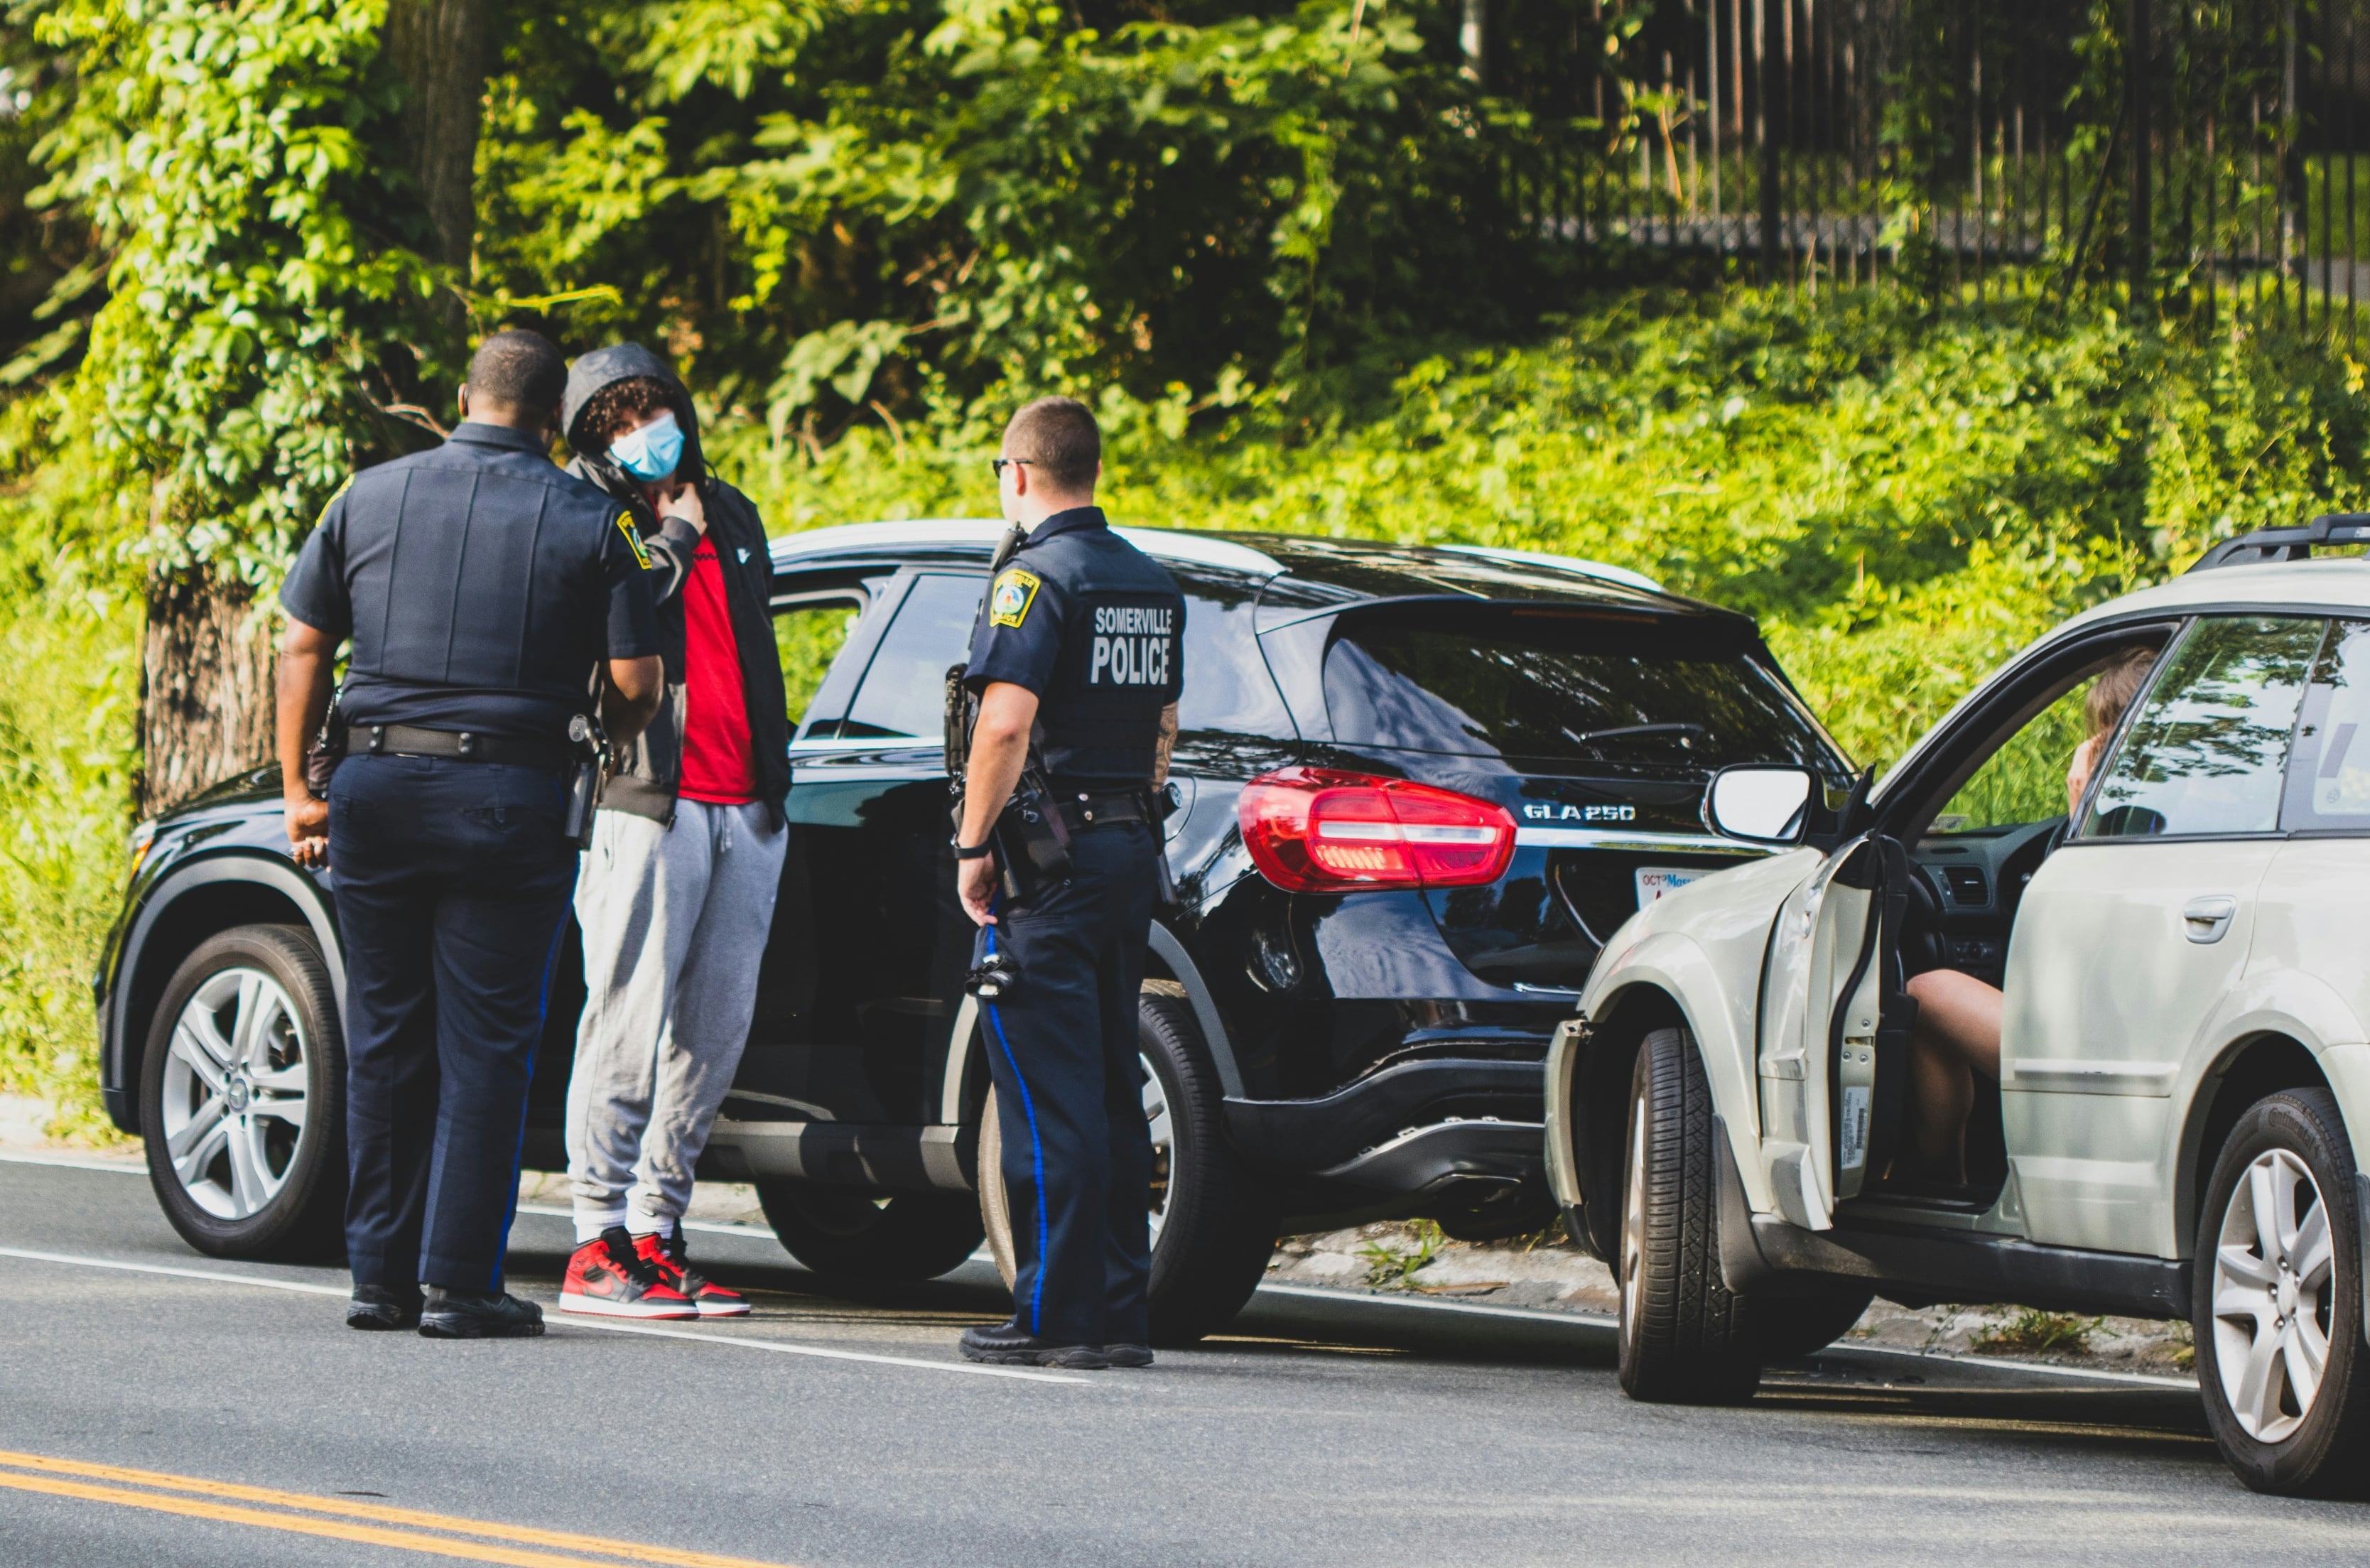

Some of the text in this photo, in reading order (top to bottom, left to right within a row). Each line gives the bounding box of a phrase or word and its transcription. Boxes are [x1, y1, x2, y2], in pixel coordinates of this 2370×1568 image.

[1095, 607, 1172, 634] SOMERVILLE
[1091, 636, 1171, 686] POLICE
[1523, 804, 1636, 821] GLA 250
[1643, 875, 1661, 886] OCT
